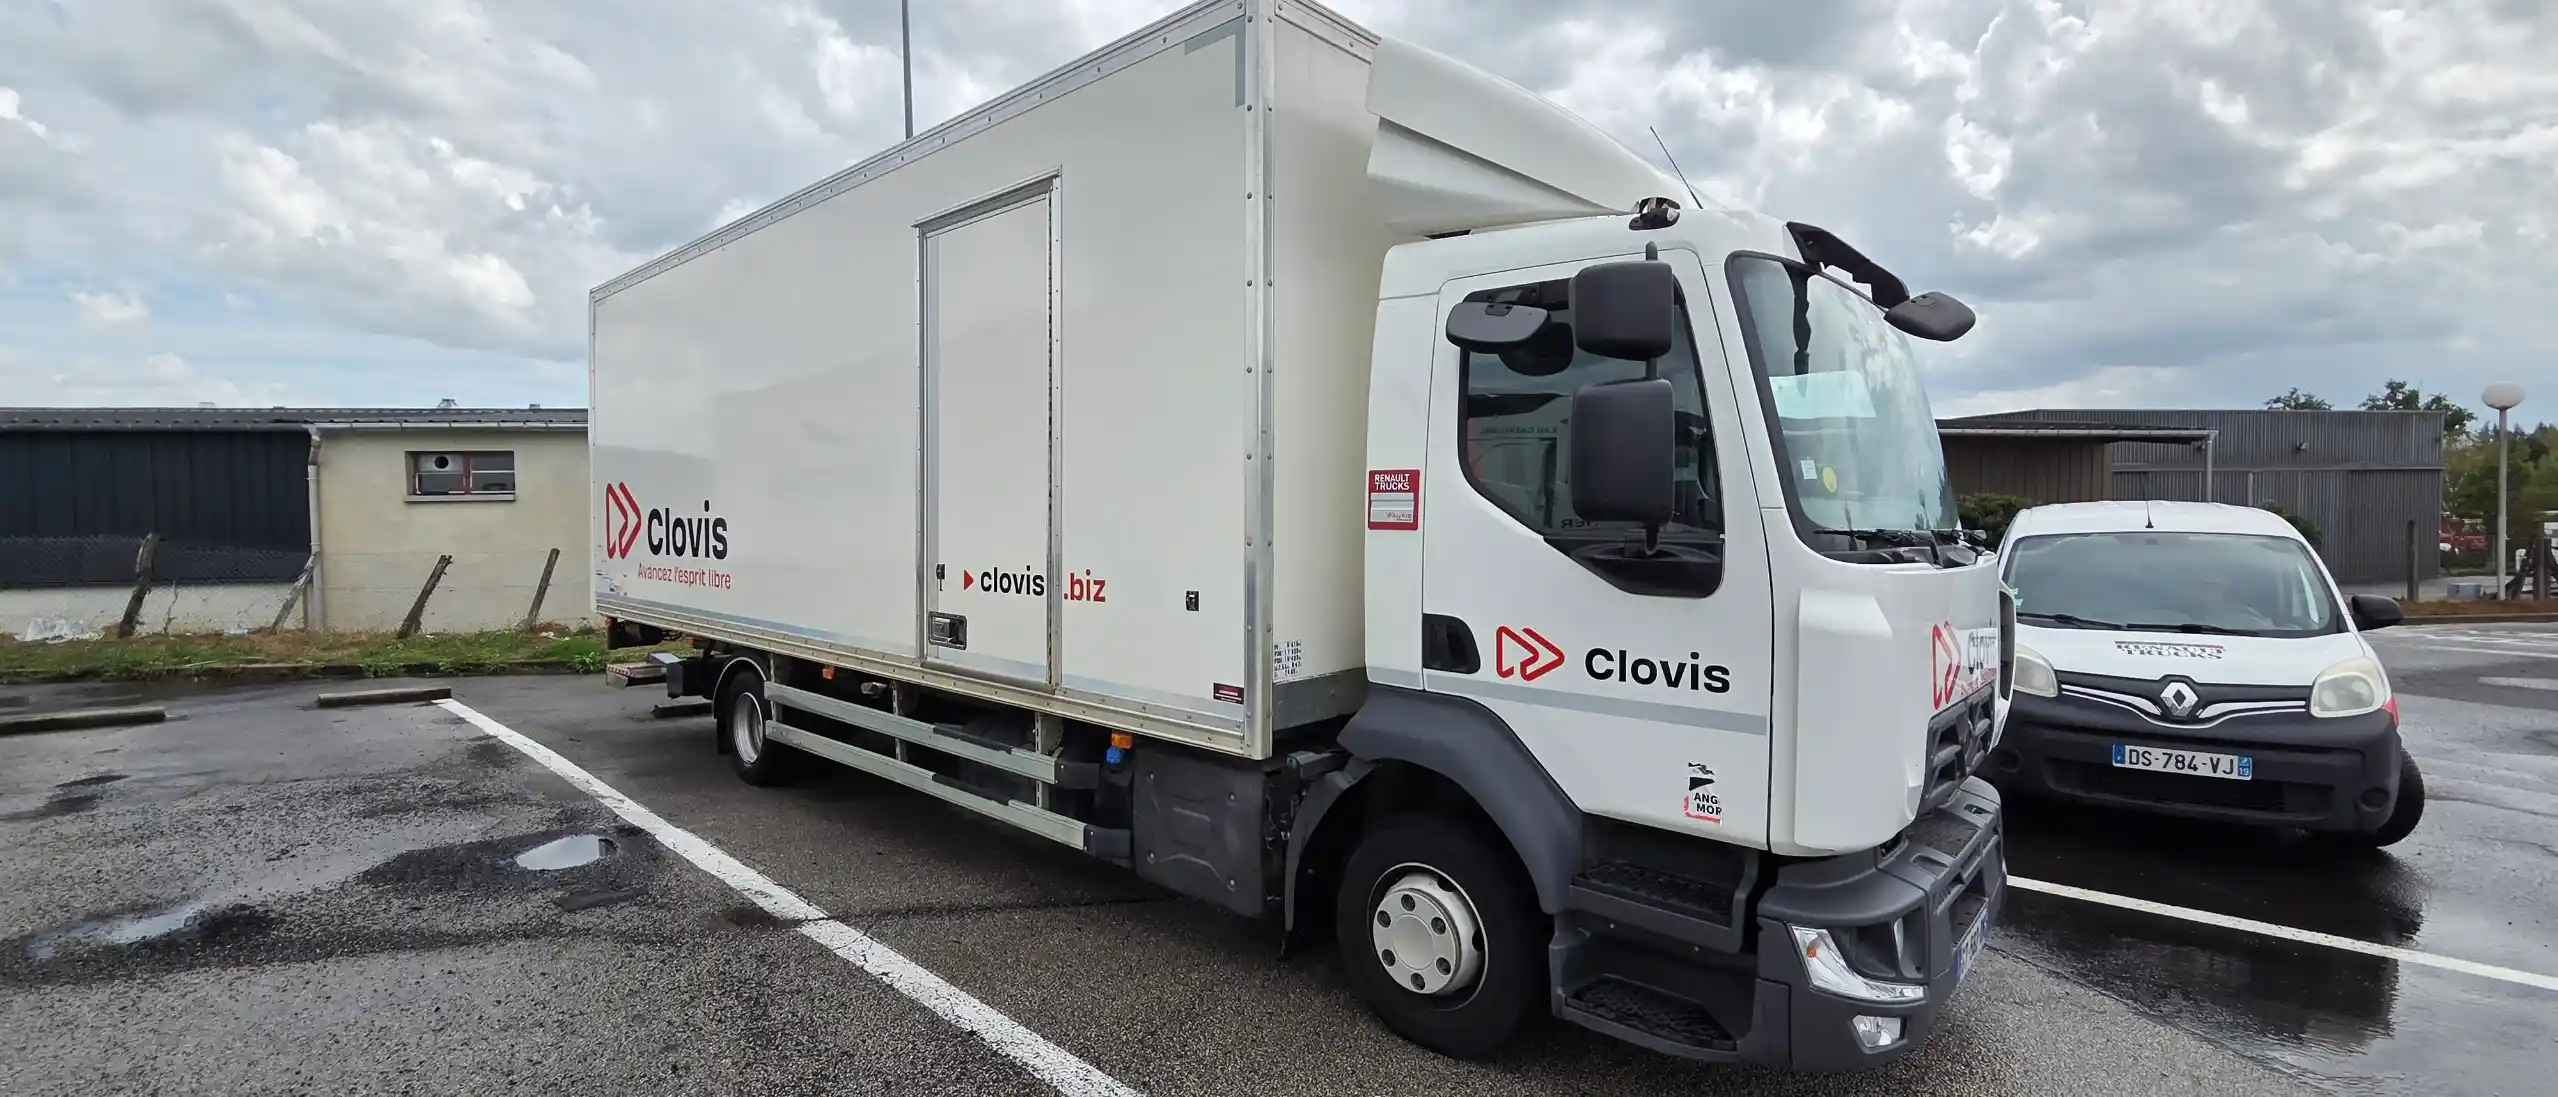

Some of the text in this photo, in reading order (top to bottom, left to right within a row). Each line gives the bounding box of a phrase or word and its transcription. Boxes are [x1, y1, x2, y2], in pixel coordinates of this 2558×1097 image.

[1374, 473, 1410, 483] RENAULT
[1375, 482, 1410, 491] TRUCKS
[647, 499, 728, 560] Clovis
[637, 561, 672, 582] Avancez
[674, 565, 706, 588] l'esprit
[708, 569, 731, 590] libre
[2116, 643, 2226, 654] RENAULT
[2127, 649, 2223, 660] TRUCKS
[1584, 647, 1731, 694] Clovis
[2128, 748, 2235, 776] DS-784-VJ
[2239, 767, 2249, 776] 19
